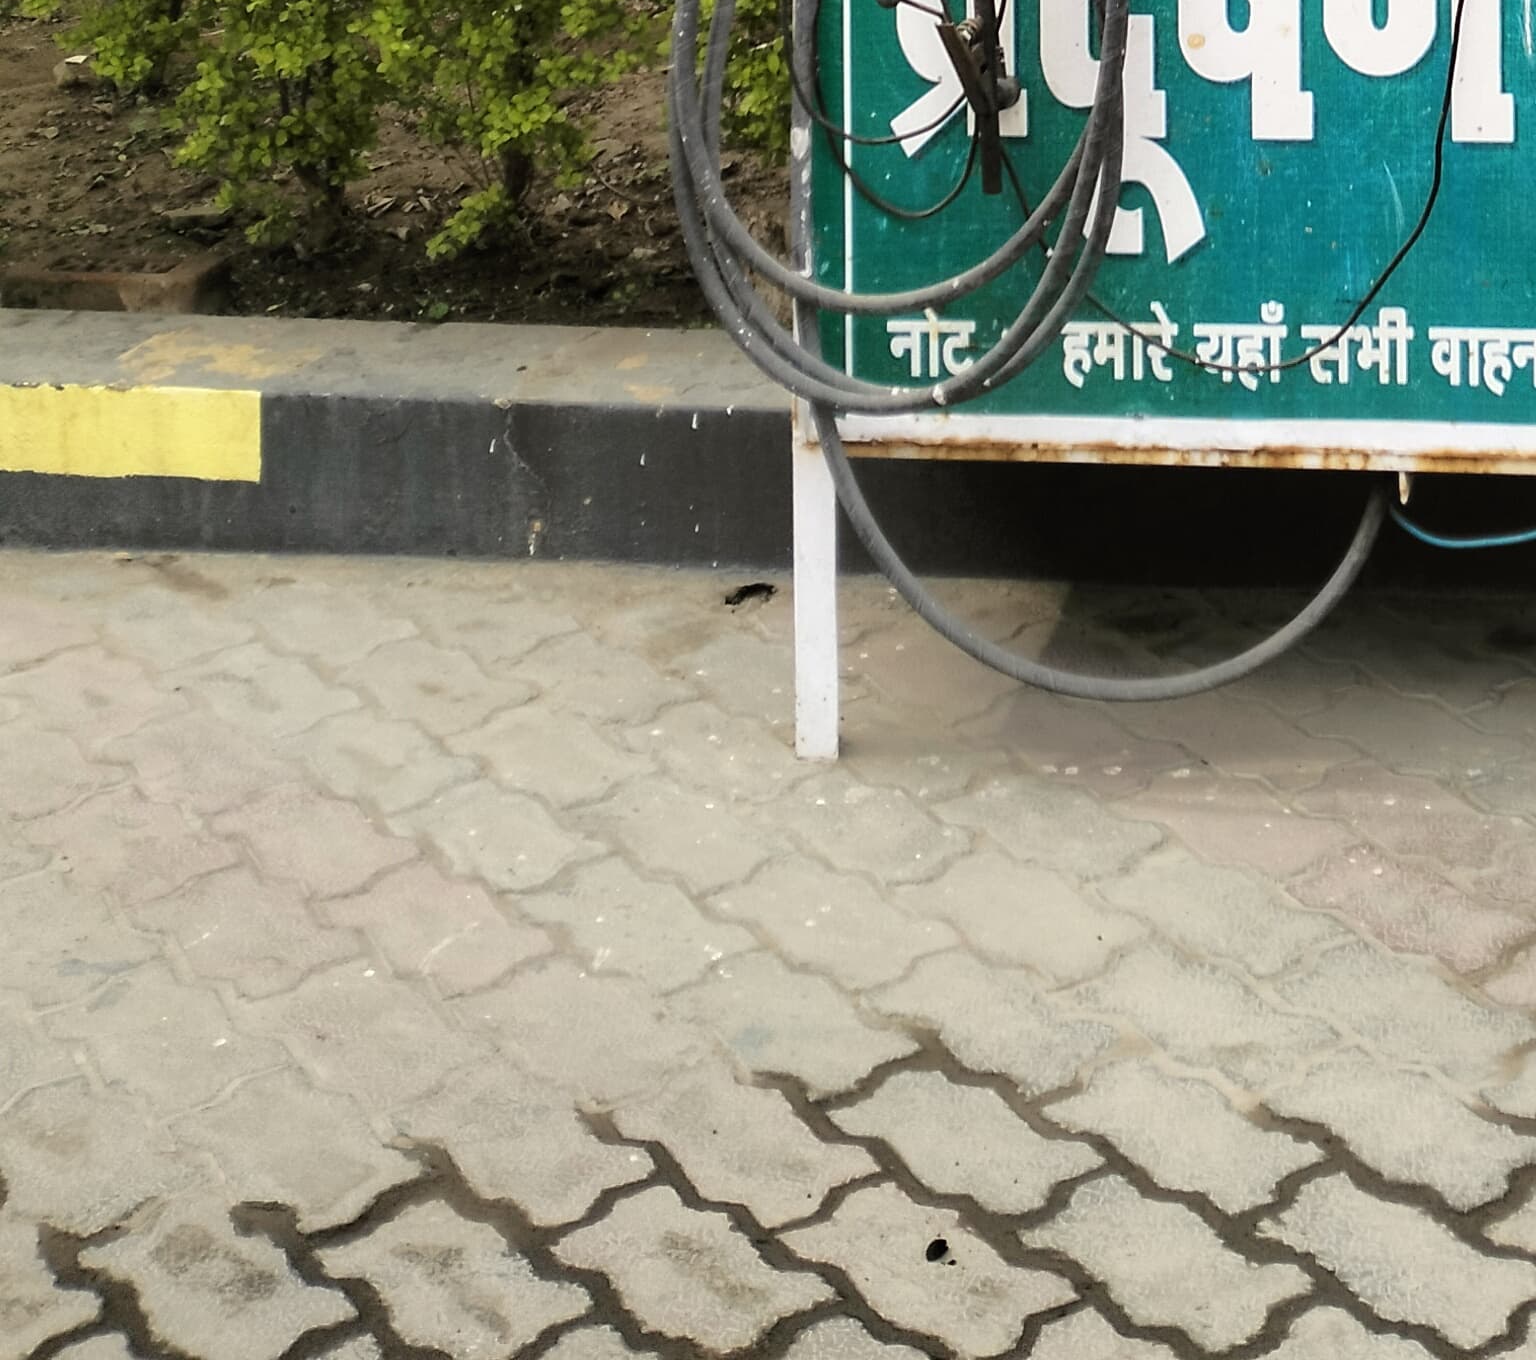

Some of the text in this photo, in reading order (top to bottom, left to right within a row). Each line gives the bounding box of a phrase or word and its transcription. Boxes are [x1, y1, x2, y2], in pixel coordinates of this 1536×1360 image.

[886, 307, 977, 378] नोट
[1060, 300, 1179, 390] हमारे
[1193, 300, 1288, 391] यहाँ
[1300, 307, 1413, 386] सभी
